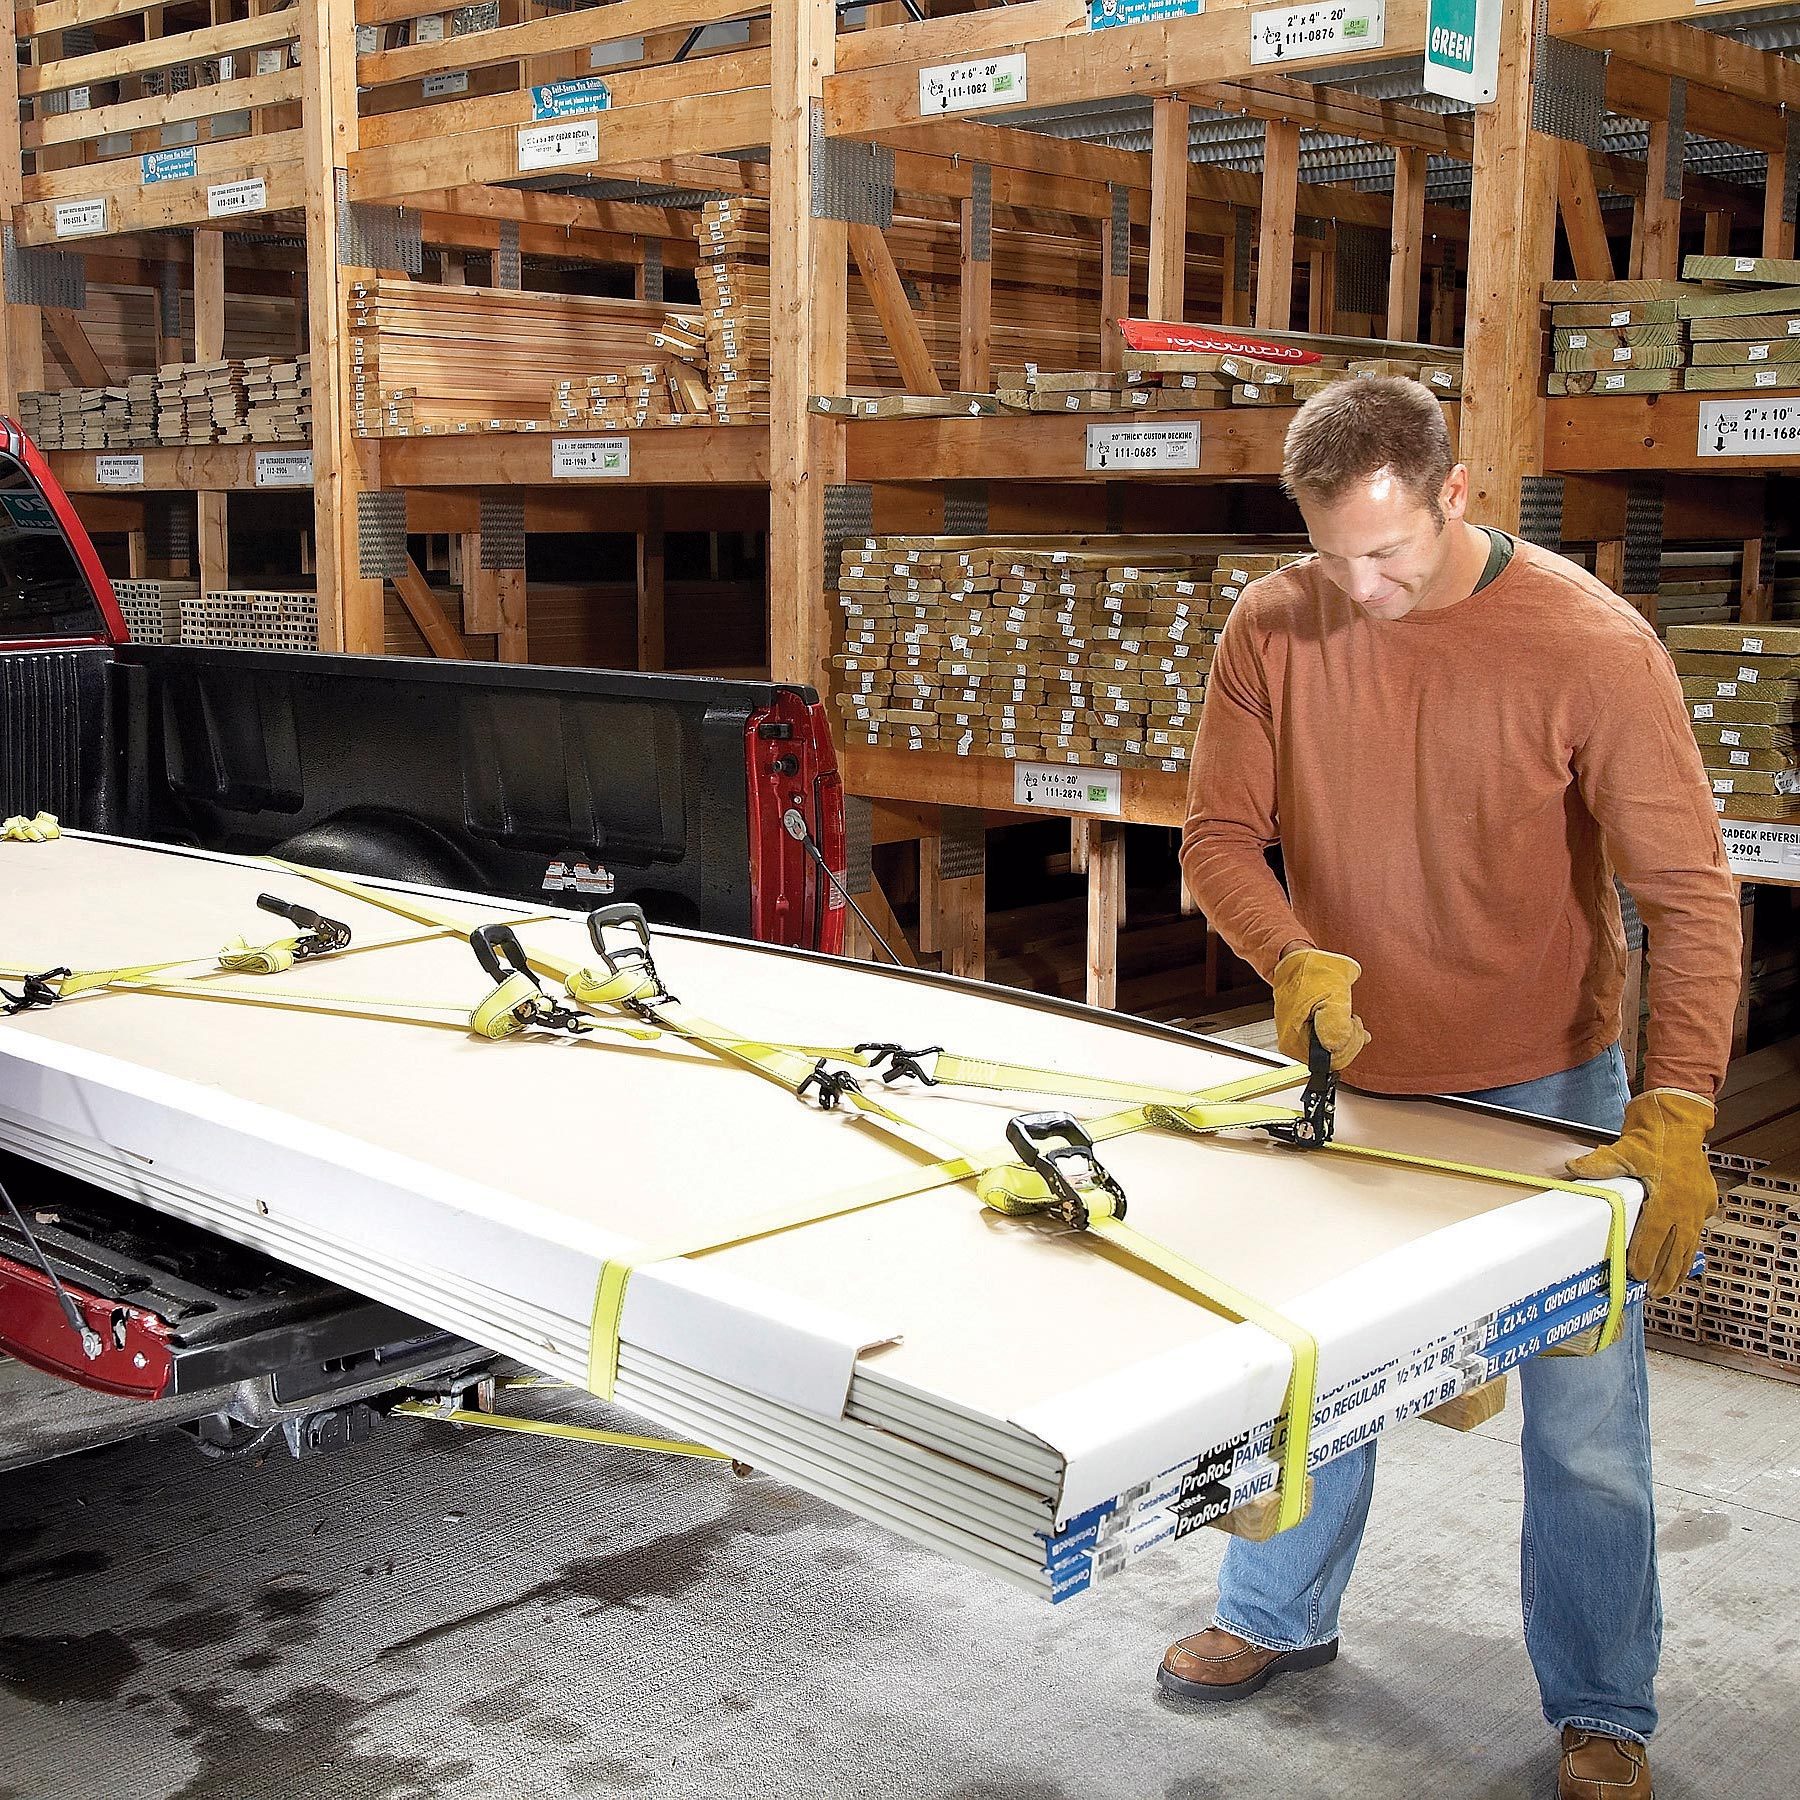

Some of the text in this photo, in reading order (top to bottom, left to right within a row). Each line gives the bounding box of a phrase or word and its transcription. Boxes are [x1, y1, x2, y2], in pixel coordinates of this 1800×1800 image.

[1288, 15, 1298, 27] 2"
[1301, 17, 1306, 25] x
[1309, 12, 1320, 24] 4"
[1331, 8, 1346, 20] 20'
[1286, 27, 1335, 44] 111-0876
[1432, 26, 1472, 63] GREEN
[961, 71, 966, 79] x
[985, 64, 997, 76] 20'
[948, 83, 987, 97] 111-1082
[1744, 408, 1758, 421] 2"
[1761, 411, 1768, 421] x
[1773, 407, 1793, 421] 10"
[1111, 433, 1120, 441] 20'
[1144, 432, 1167, 440] CUSTOM
[1168, 431, 1193, 440] DECKING
[1115, 447, 1157, 458] 111-0685
[1041, 773, 1046, 781] 6
[1054, 774, 1059, 782] 6
[1067, 776, 1078, 784] 20'
[1045, 786, 1083, 800] 111-2874
[1544, 1283, 1577, 1312] BOARD
[1546, 1316, 1579, 1345] BOARD
[1181, 1459, 1231, 1496] ProRoc
[1235, 1436, 1275, 1470] PANEL
[1333, 1378, 1386, 1417] REGULAR
[1440, 1344, 1456, 1365] BR
[1177, 1498, 1228, 1537] ProRoc
[1232, 1472, 1273, 1507] PANEL
[1332, 1414, 1384, 1456] REGULAR
[1439, 1378, 1456, 1400] BR
